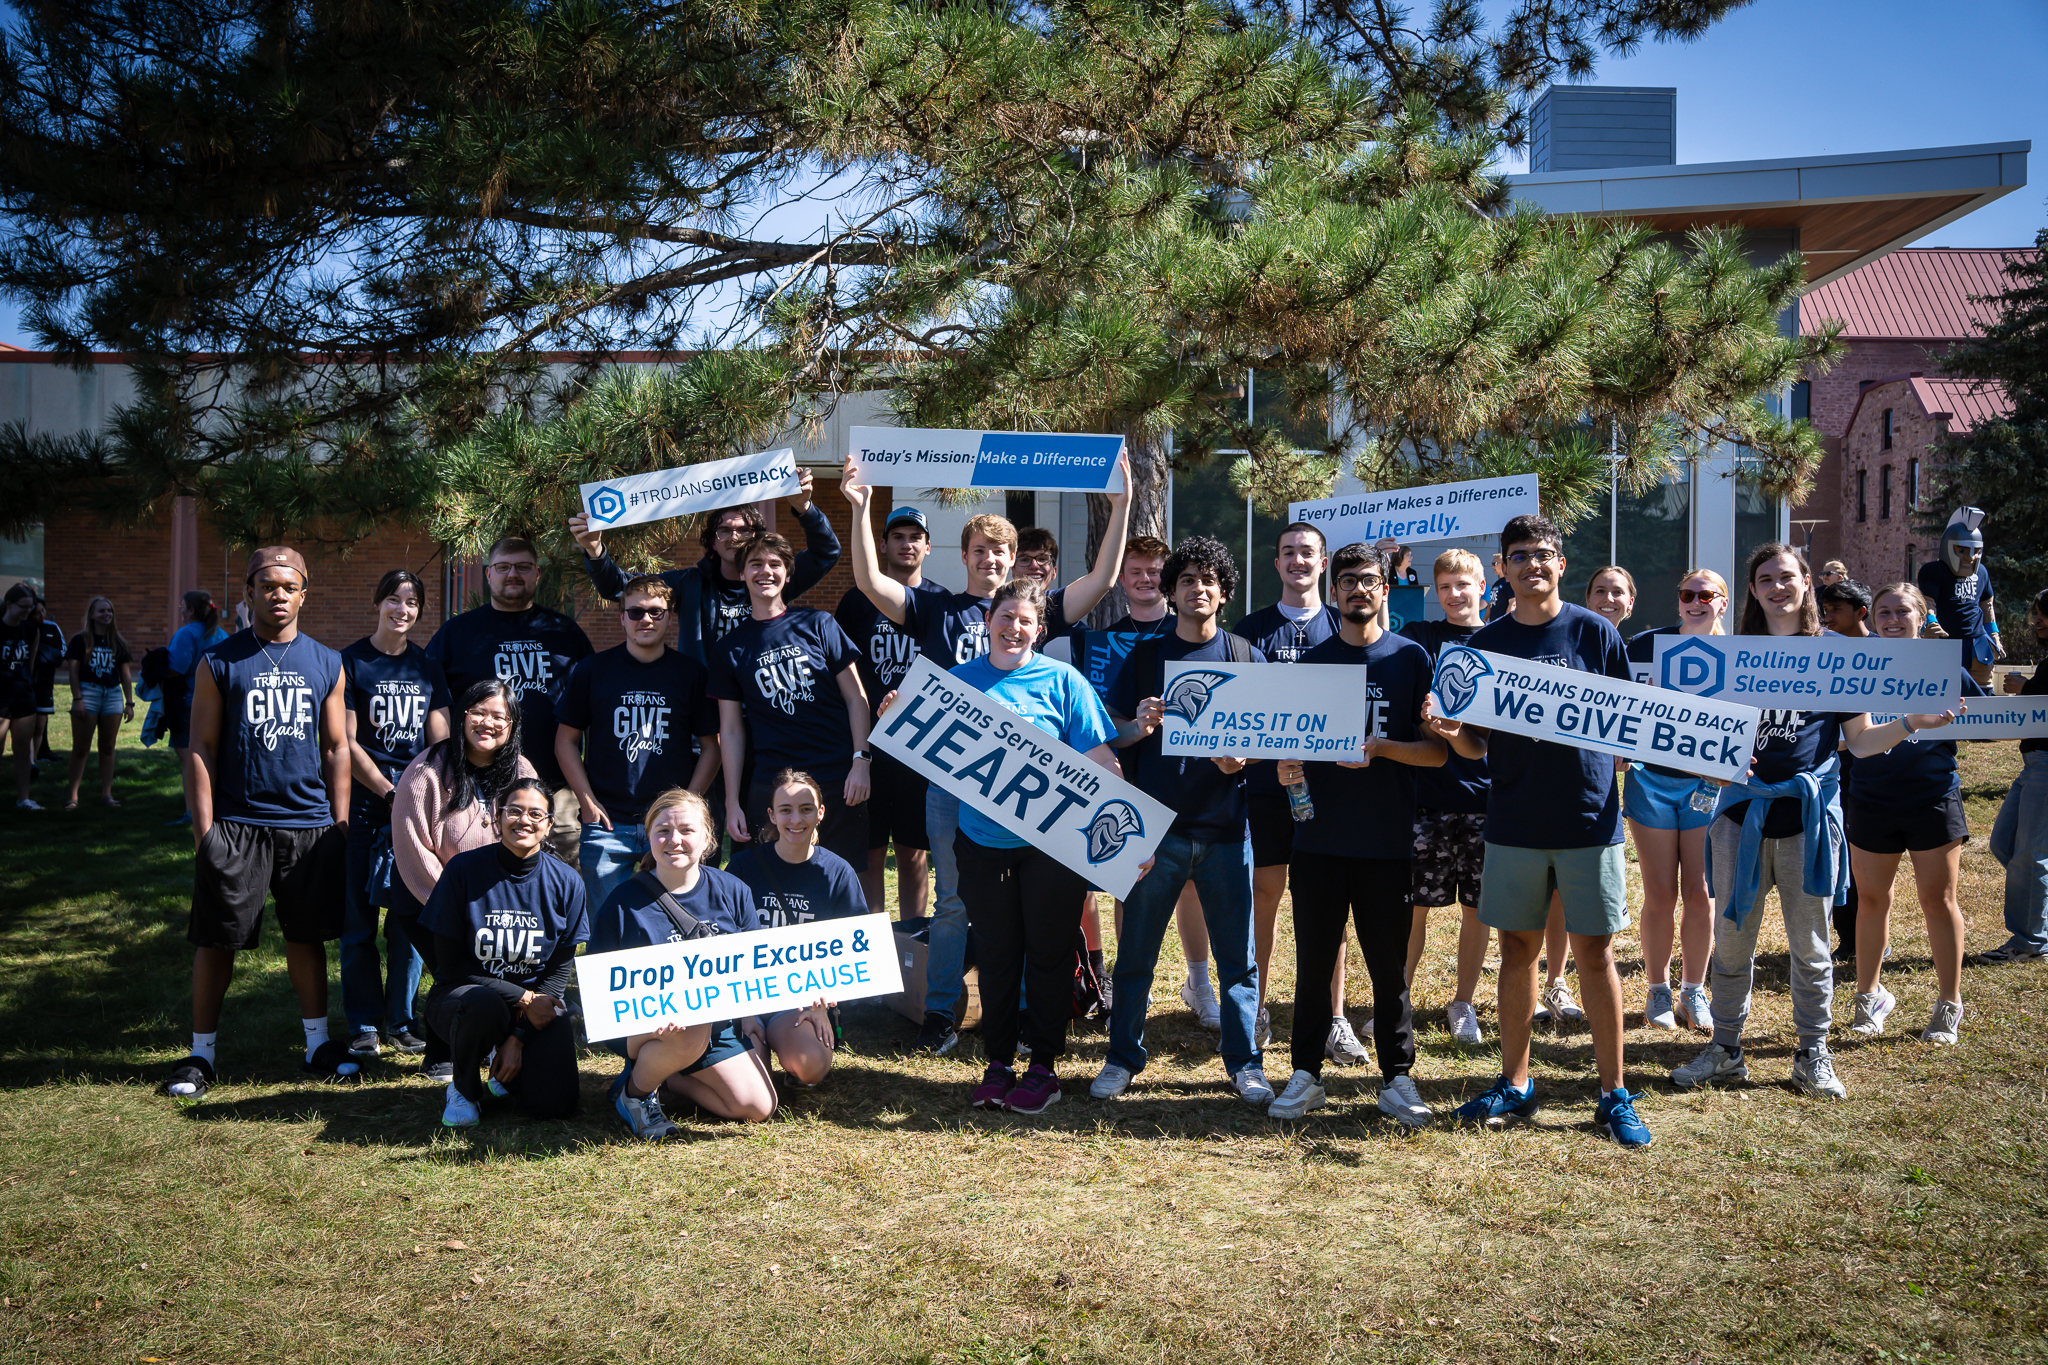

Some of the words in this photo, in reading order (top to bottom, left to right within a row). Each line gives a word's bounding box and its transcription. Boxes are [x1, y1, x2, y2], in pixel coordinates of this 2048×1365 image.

[861, 449, 912, 465] Today's
[916, 449, 976, 464] Mission:
[979, 450, 1017, 465] Make
[1020, 454, 1029, 465] a
[1032, 452, 1107, 467] Difference
[630, 465, 791, 507] #TROJANSGIVEBACK
[1298, 507, 1337, 522] Every
[1340, 502, 1383, 517] Dollar
[1387, 496, 1432, 512] Makes
[1436, 496, 1444, 506] a
[1447, 486, 1528, 505] Difference.
[1365, 513, 1460, 540] Literally.
[89, 652, 116, 669] GIVE
[494, 651, 553, 680] GIVE
[754, 655, 816, 699] GIVE
[1734, 650, 1811, 674] Rolling
[1816, 652, 1846, 674] Up
[1851, 652, 1893, 671] Our
[1496, 669, 1578, 699] TROJANS
[1580, 688, 1639, 712] DON'T
[1640, 700, 1692, 723] HOLD
[1694, 712, 1749, 736] BACK
[1733, 674, 1823, 697] Sleeves,
[1829, 677, 1877, 696] DSU
[1880, 677, 1949, 701] Style!
[246, 688, 313, 725] GIVE
[369, 695, 426, 728] GIVE
[613, 706, 672, 739] GIVE
[1211, 711, 1265, 731] PASS
[1270, 713, 1292, 732] IT
[1296, 713, 1327, 733] ON
[1950, 710, 2027, 727] mmunity
[2032, 709, 2048, 723] M
[921, 673, 995, 729] Trojans
[993, 721, 1054, 767] Serve
[1055, 760, 1101, 796] with
[1169, 730, 1220, 750] Giving
[1223, 732, 1237, 747] is
[1241, 736, 1251, 748] a
[1256, 733, 1299, 749] Team
[1303, 734, 1357, 753] Sport!
[1493, 687, 1545, 724] We
[1556, 703, 1642, 746] GIVE
[1651, 721, 1743, 767] Back
[884, 694, 1091, 835] HEART
[475, 928, 545, 964] GIVE
[609, 964, 675, 992] Drop
[683, 953, 745, 980] Your
[753, 938, 844, 970] Excuse
[851, 929, 871, 953] &
[613, 991, 679, 1023] PICK
[684, 985, 720, 1011] UP
[727, 976, 780, 1004] THE
[786, 961, 871, 995] CAUSE
